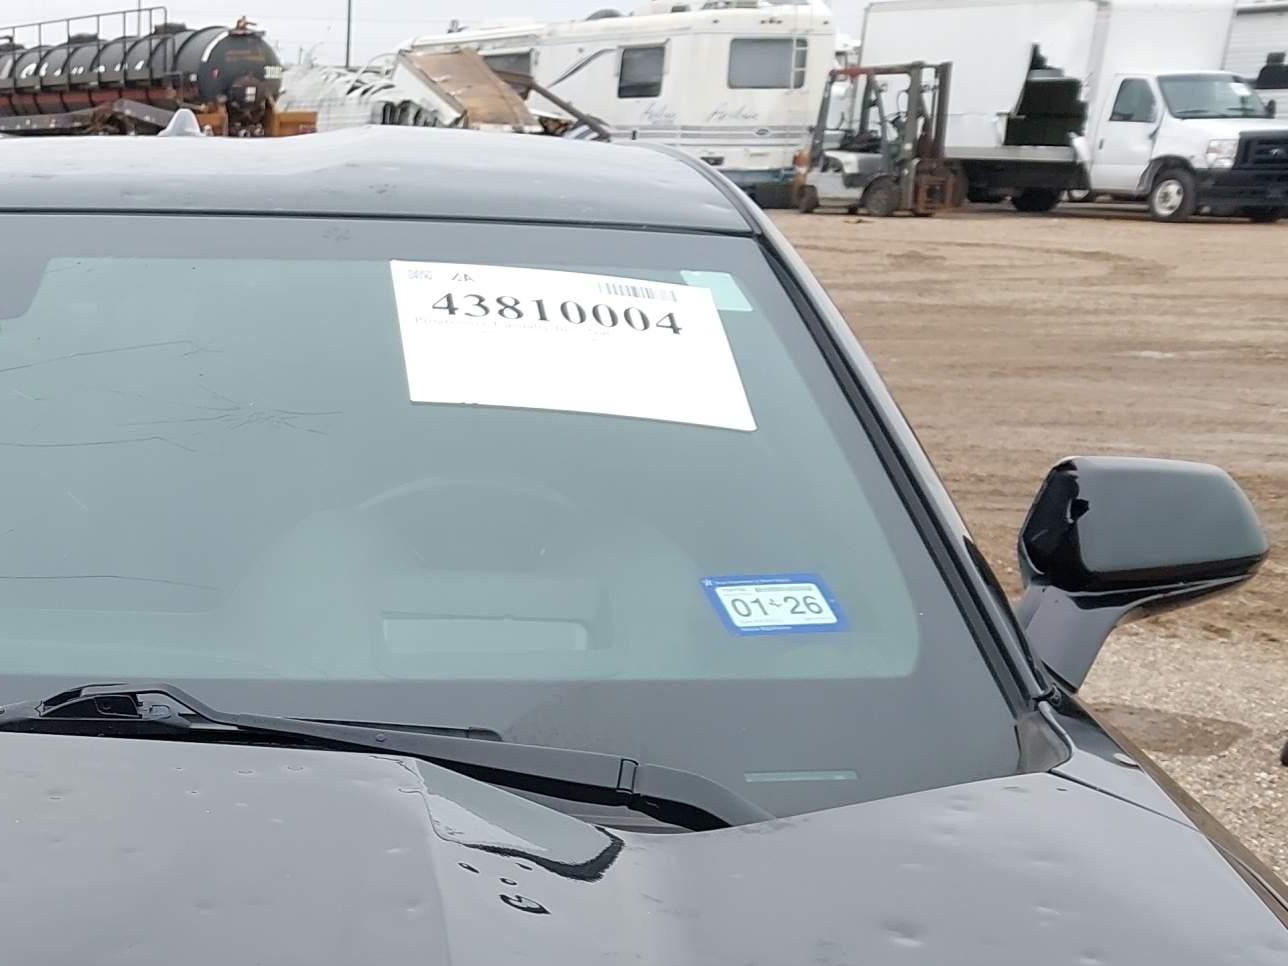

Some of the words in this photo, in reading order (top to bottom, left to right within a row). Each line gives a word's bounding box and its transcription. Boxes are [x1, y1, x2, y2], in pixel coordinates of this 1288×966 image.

[430, 290, 684, 336] 43810004
[730, 597, 769, 618] 01
[783, 595, 824, 615] 26
